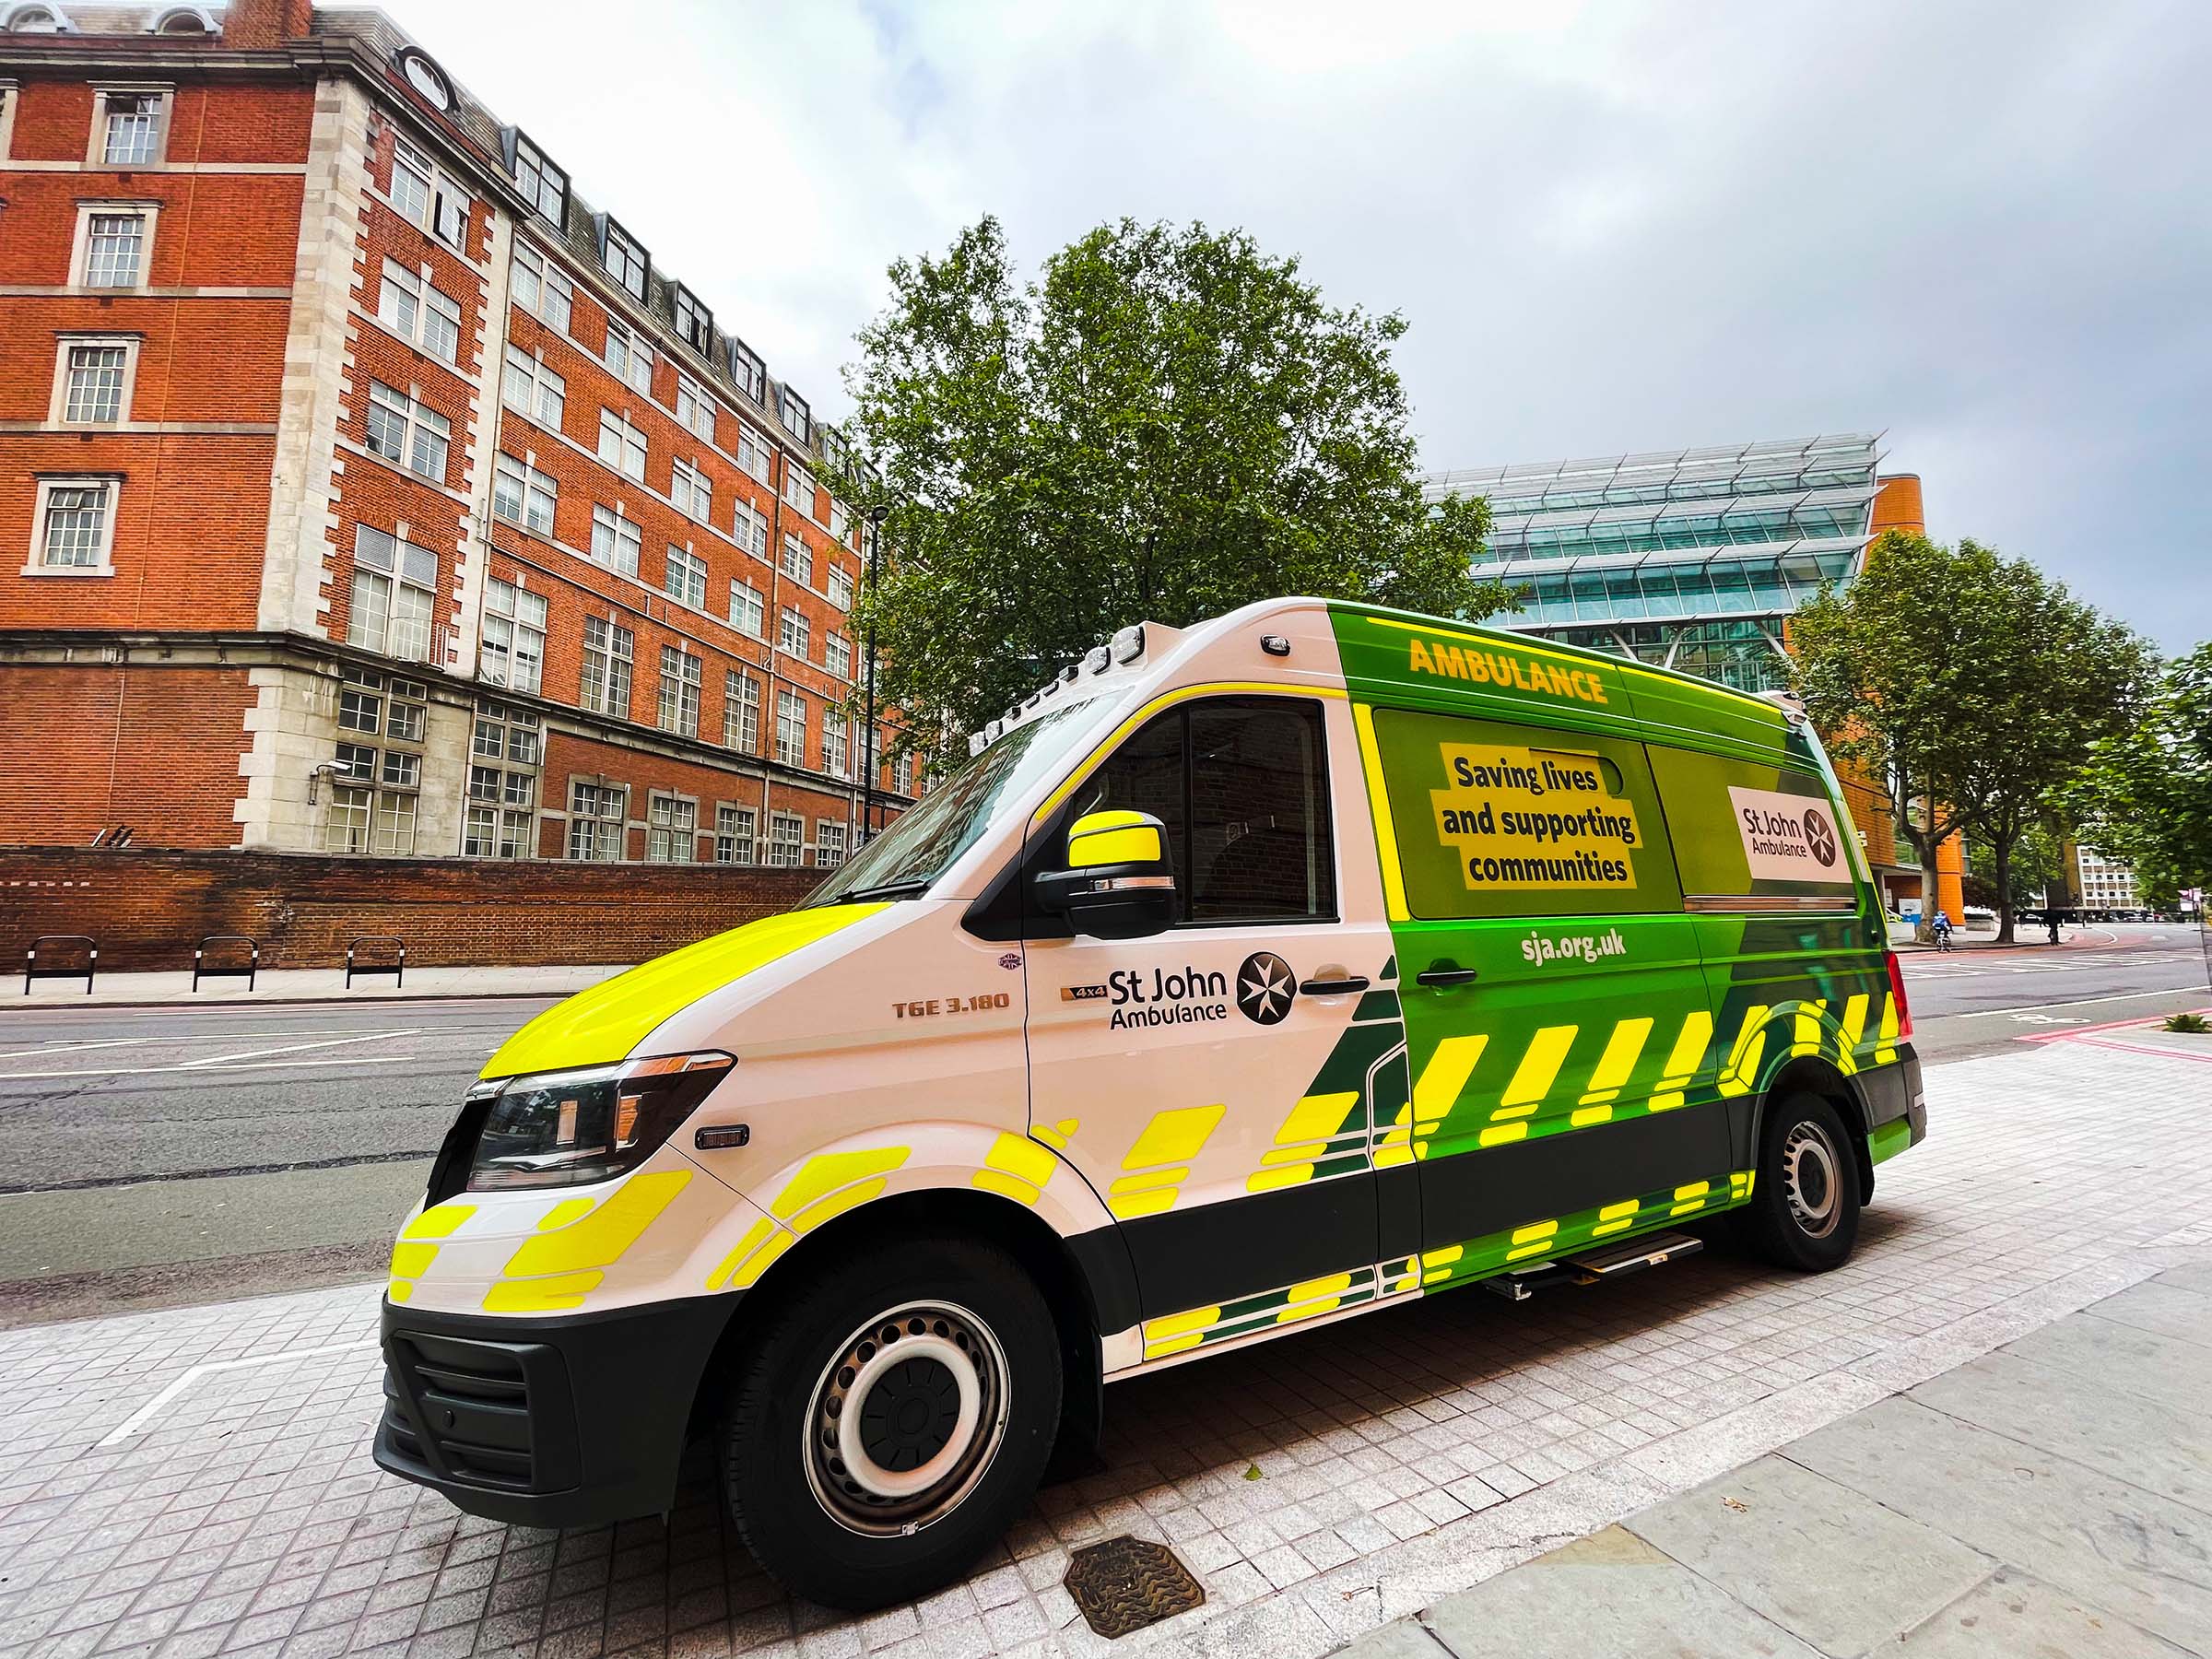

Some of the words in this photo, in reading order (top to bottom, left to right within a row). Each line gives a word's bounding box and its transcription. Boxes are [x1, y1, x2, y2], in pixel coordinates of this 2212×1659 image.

[1409, 639, 1608, 704] AMBULANCE
[1453, 756, 1545, 795] Saving
[1541, 760, 1598, 790] lives
[1441, 802, 1496, 834] and
[1500, 806, 1636, 844] supporting
[1743, 807, 1765, 835] St
[1763, 811, 1802, 838] John
[1752, 837, 1807, 858] Ambulance
[1469, 850, 1628, 882] communities
[1521, 927, 1628, 967] sja.org.uk
[1076, 986, 1106, 998] 4x4
[1109, 971, 1146, 1005] St
[1151, 966, 1228, 1002] John
[891, 999, 941, 1018] TGE
[946, 993, 1010, 1014] 3.180
[1110, 1003, 1228, 1030] Ambulance
